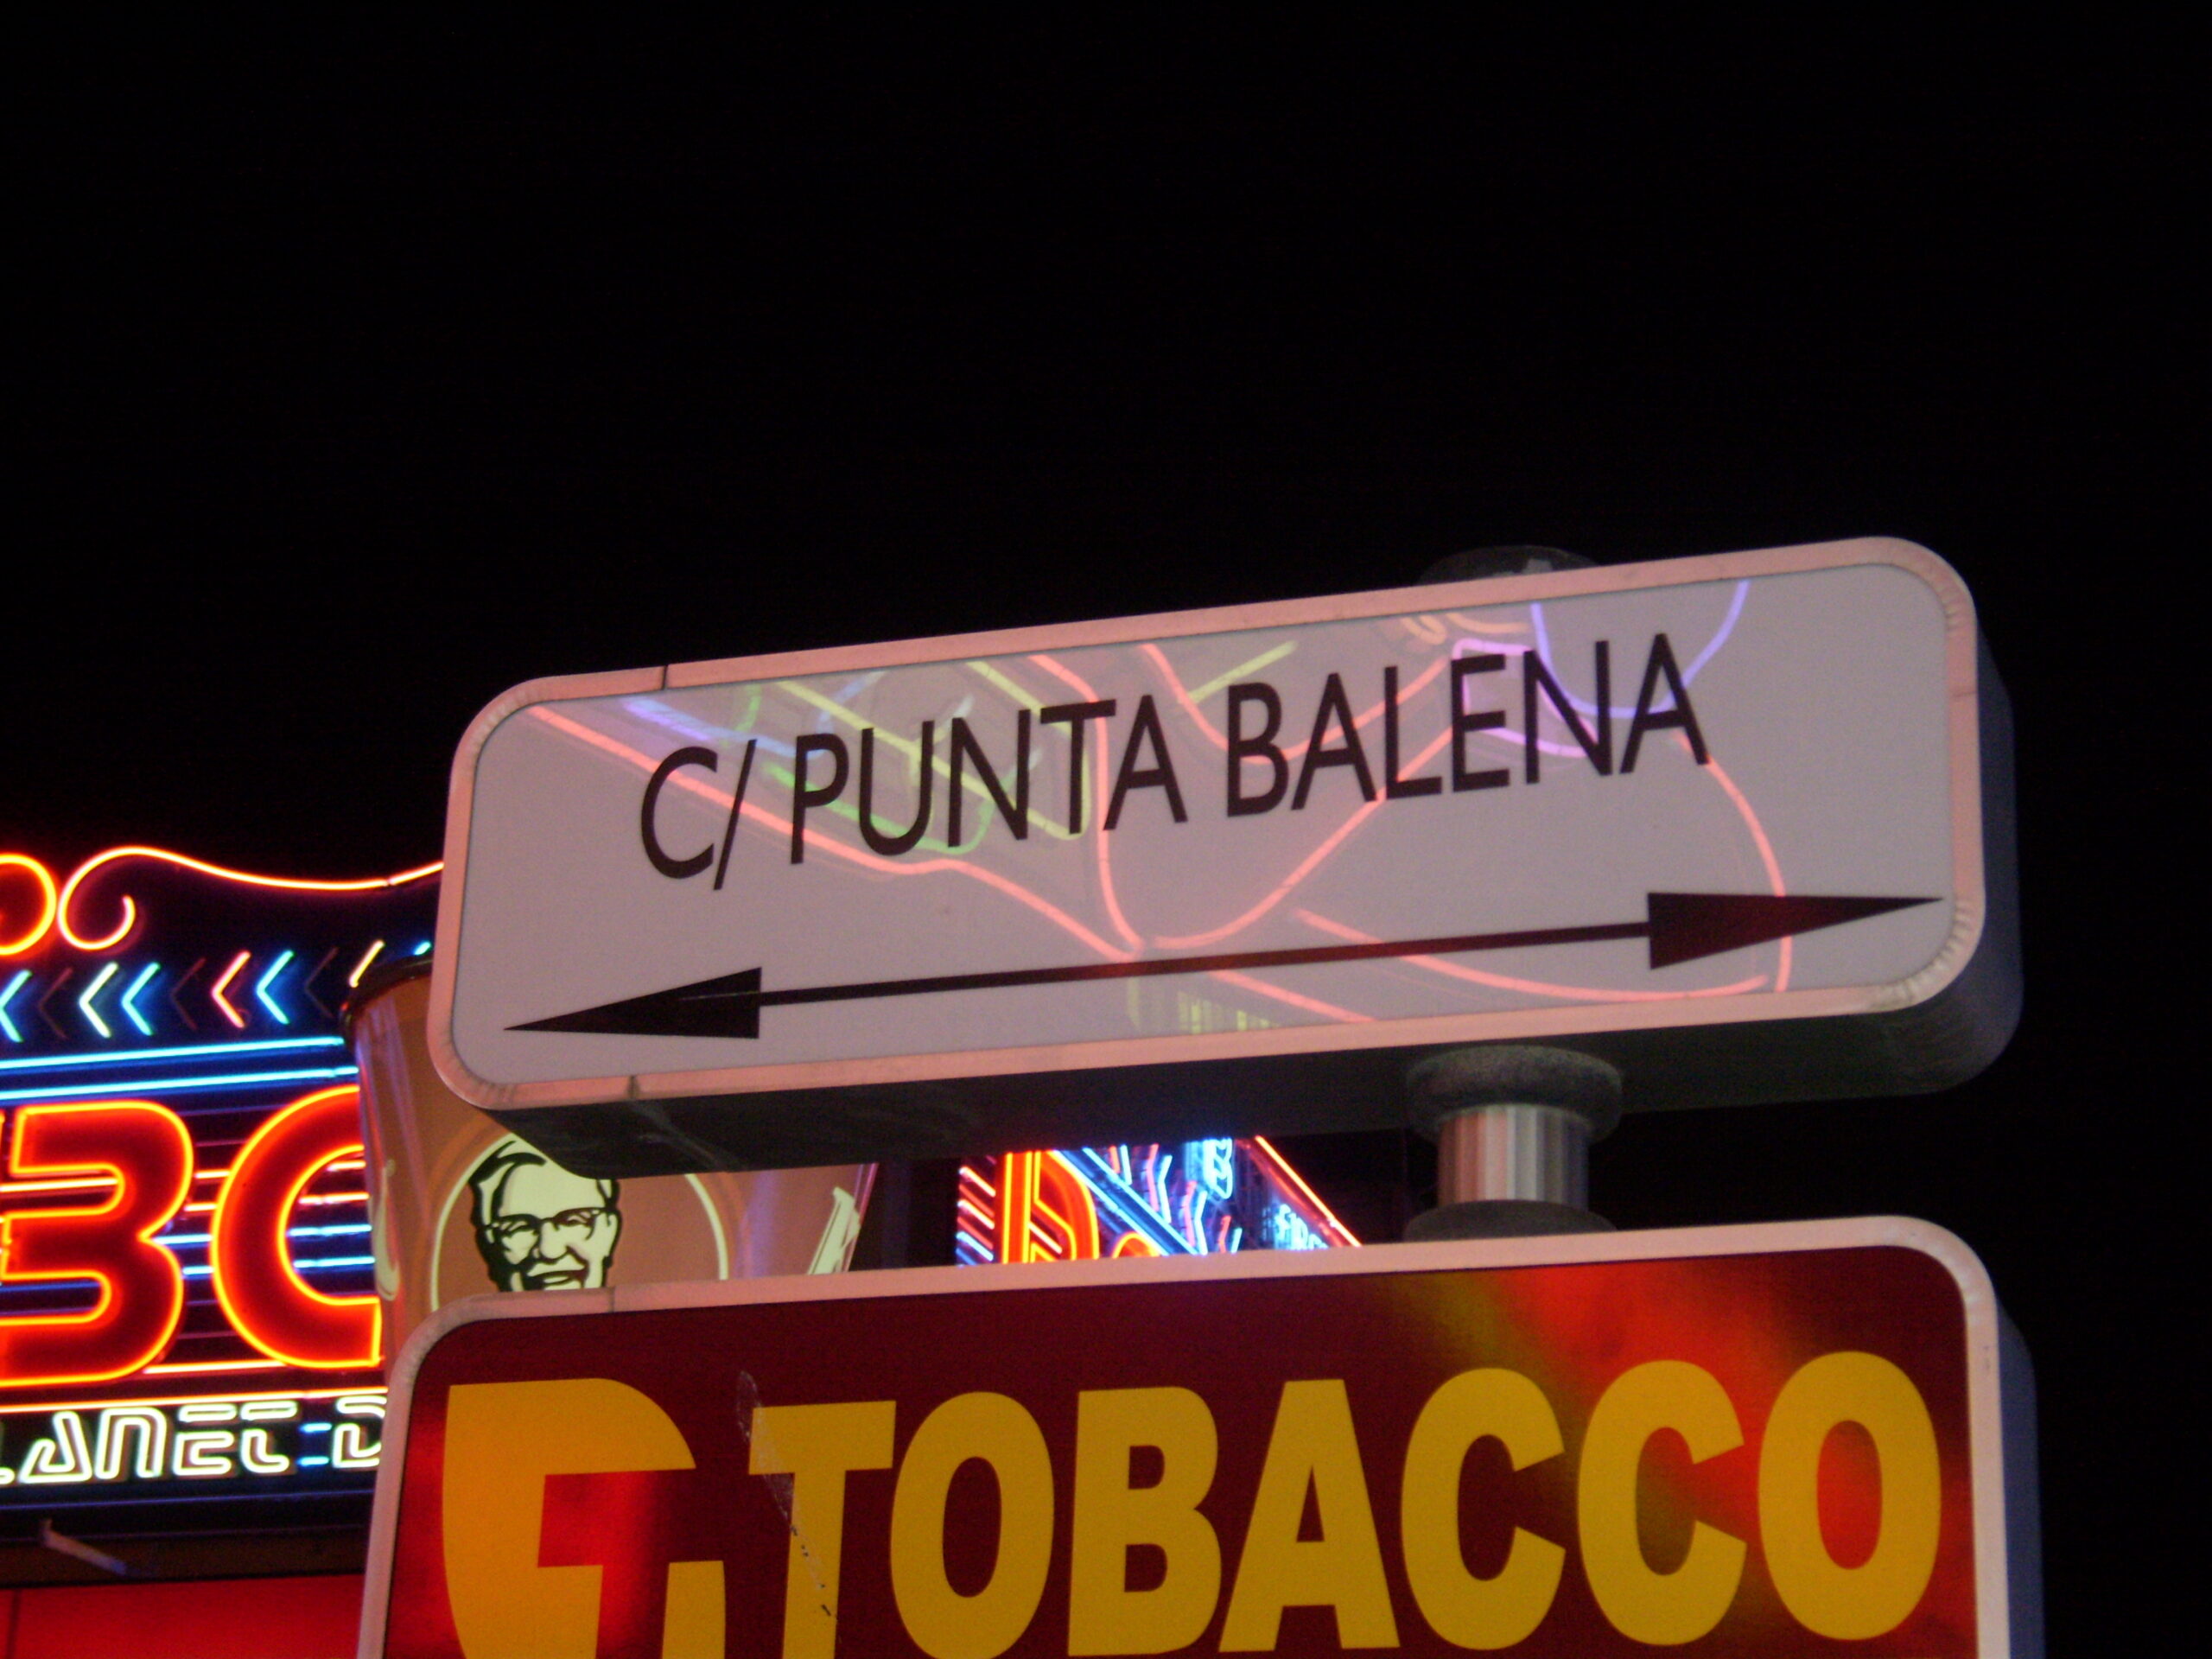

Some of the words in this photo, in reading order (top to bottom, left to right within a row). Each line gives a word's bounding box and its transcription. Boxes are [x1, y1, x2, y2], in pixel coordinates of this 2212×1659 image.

[640, 738, 758, 891] C/
[790, 694, 1189, 865] PUNTA
[1226, 632, 1710, 817] BALENA
[747, 1351, 1942, 1659] TOBACCO
